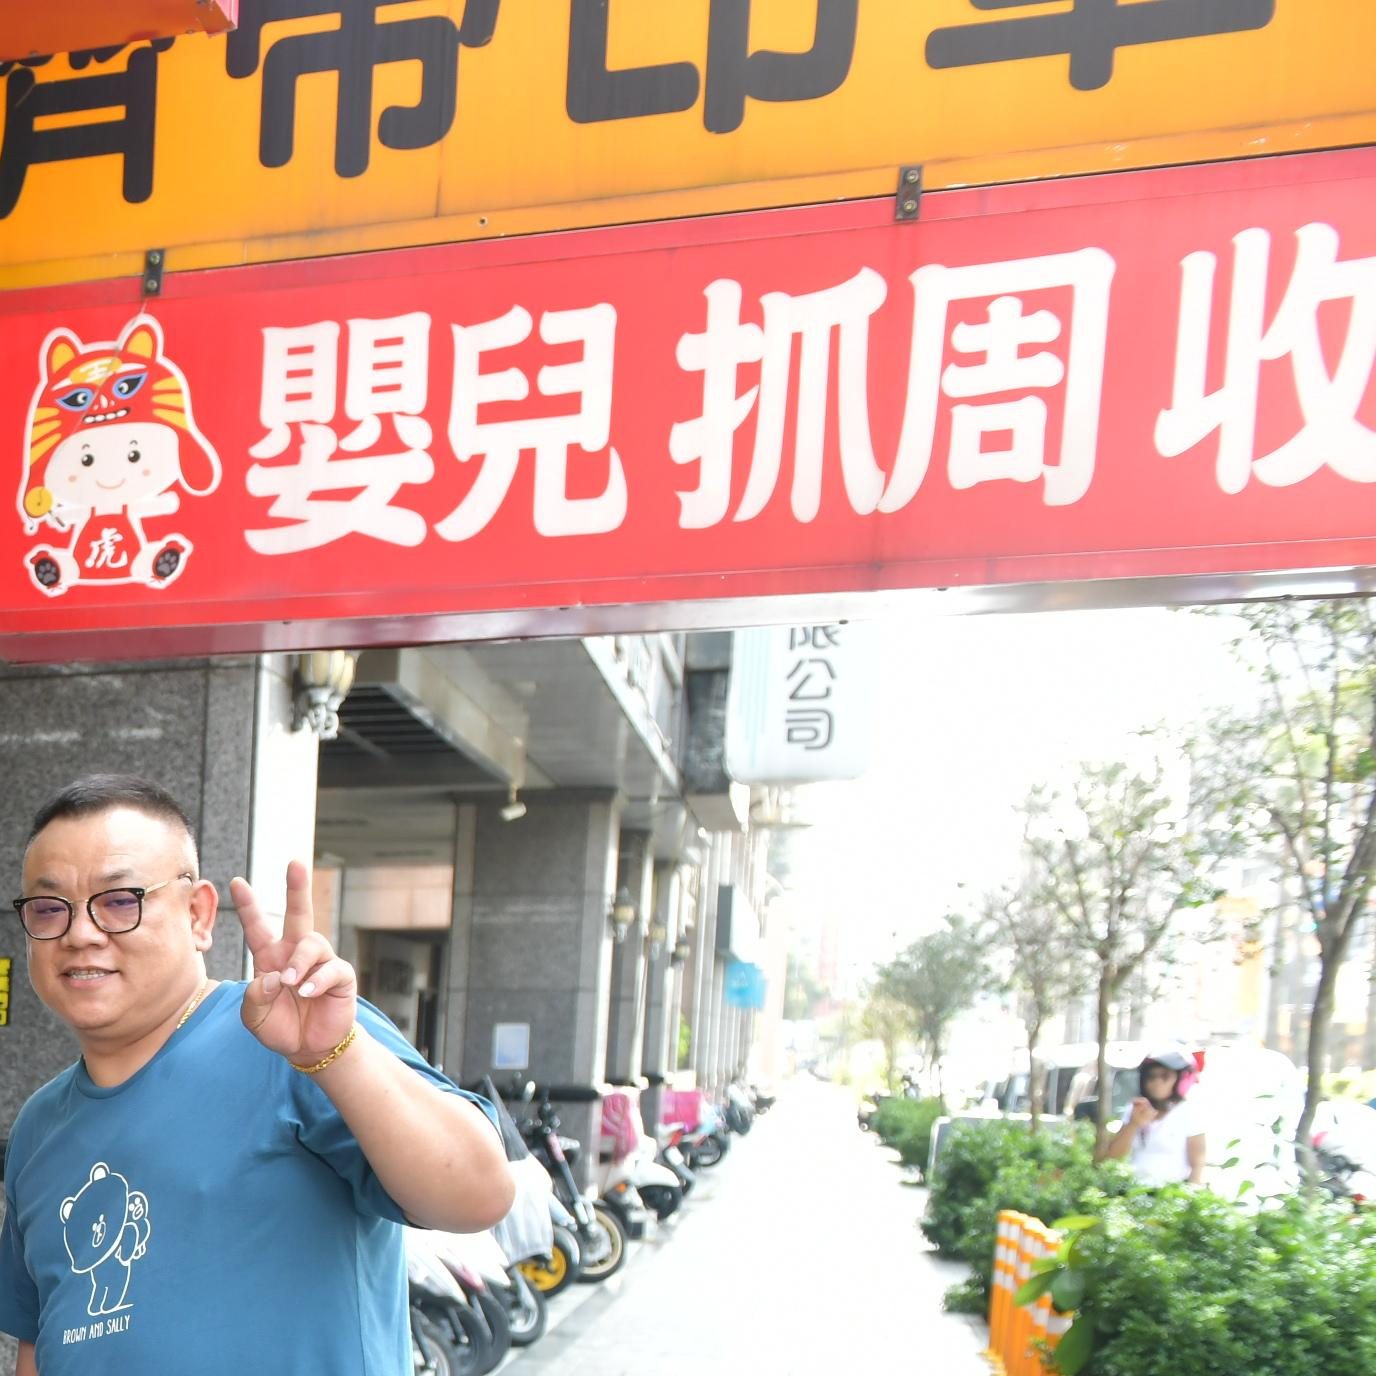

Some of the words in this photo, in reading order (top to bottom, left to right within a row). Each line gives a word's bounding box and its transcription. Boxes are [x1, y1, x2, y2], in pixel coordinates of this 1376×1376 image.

[84, 527, 129, 569] 虎
[62, 1326, 87, 1345] BROWN
[89, 1322, 104, 1339] AND
[106, 1314, 131, 1336] SALLY
